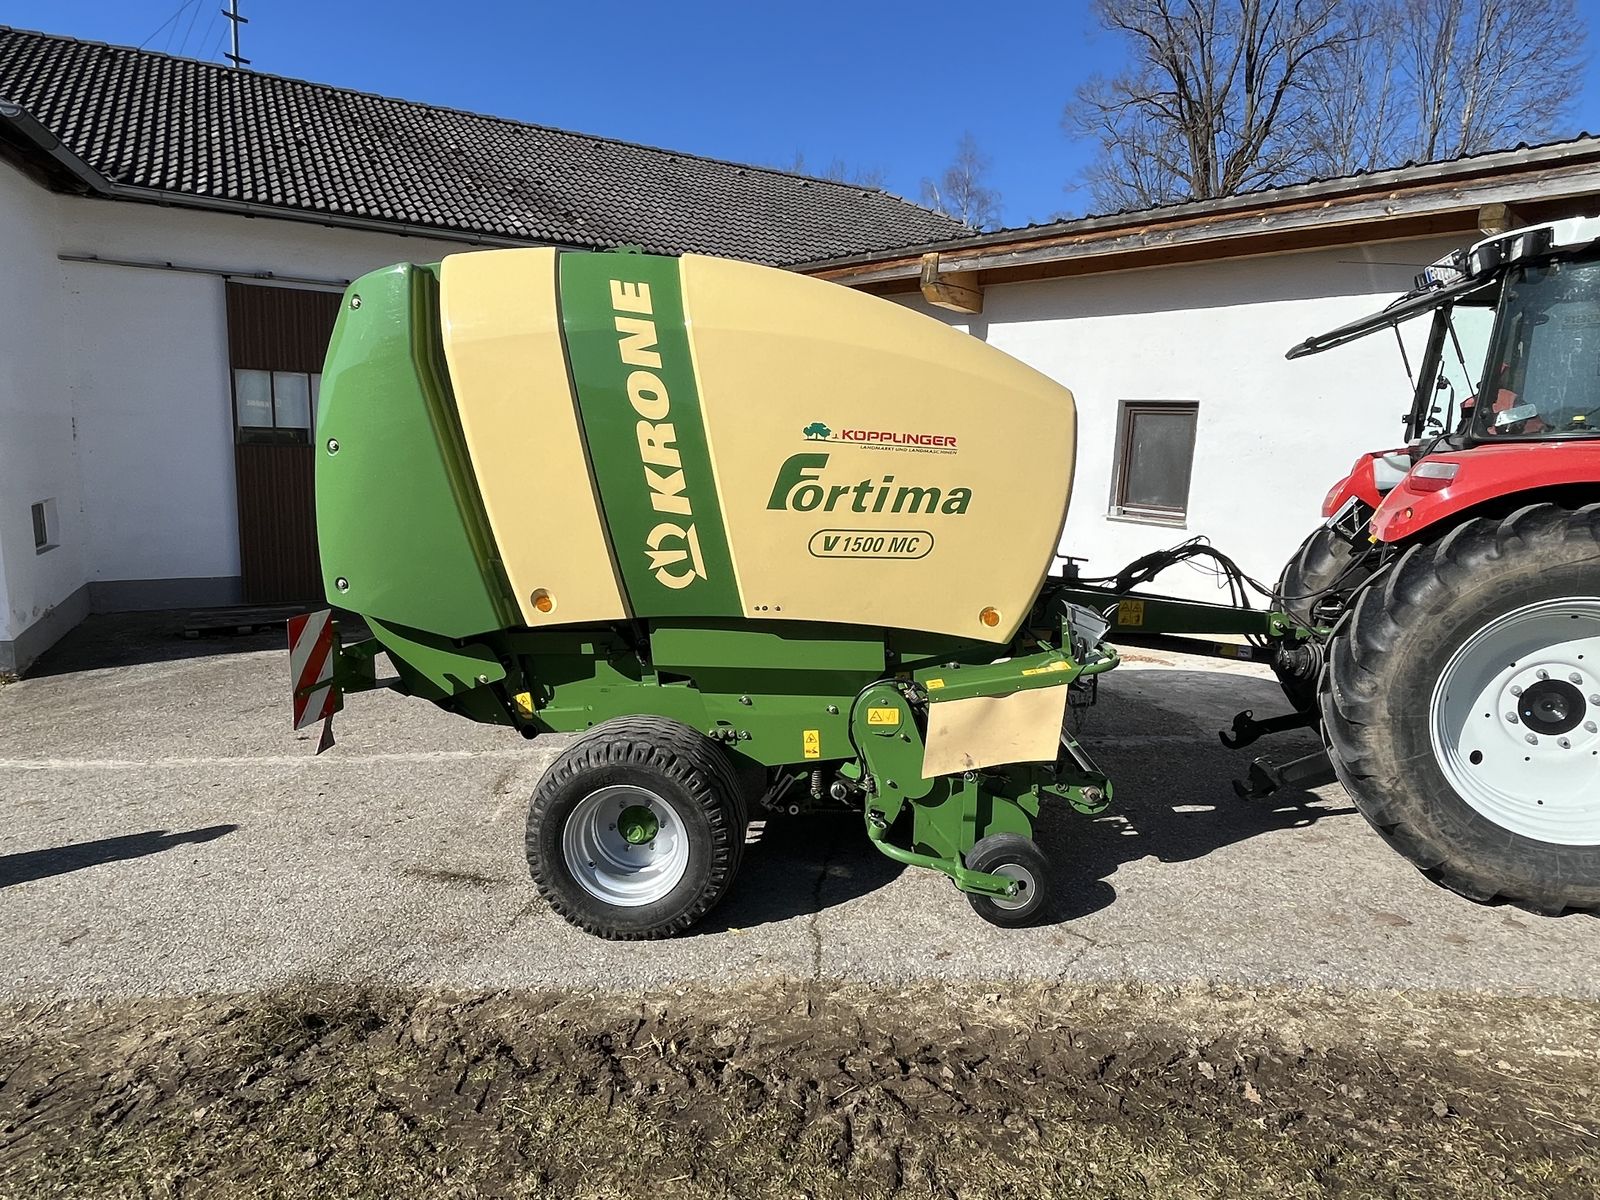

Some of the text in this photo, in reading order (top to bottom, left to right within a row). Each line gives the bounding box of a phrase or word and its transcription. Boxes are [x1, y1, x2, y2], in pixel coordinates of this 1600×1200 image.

[610, 279, 693, 516] KRONE
[766, 453, 972, 515] Fortima
[823, 536, 920, 553] V 1500 MC
